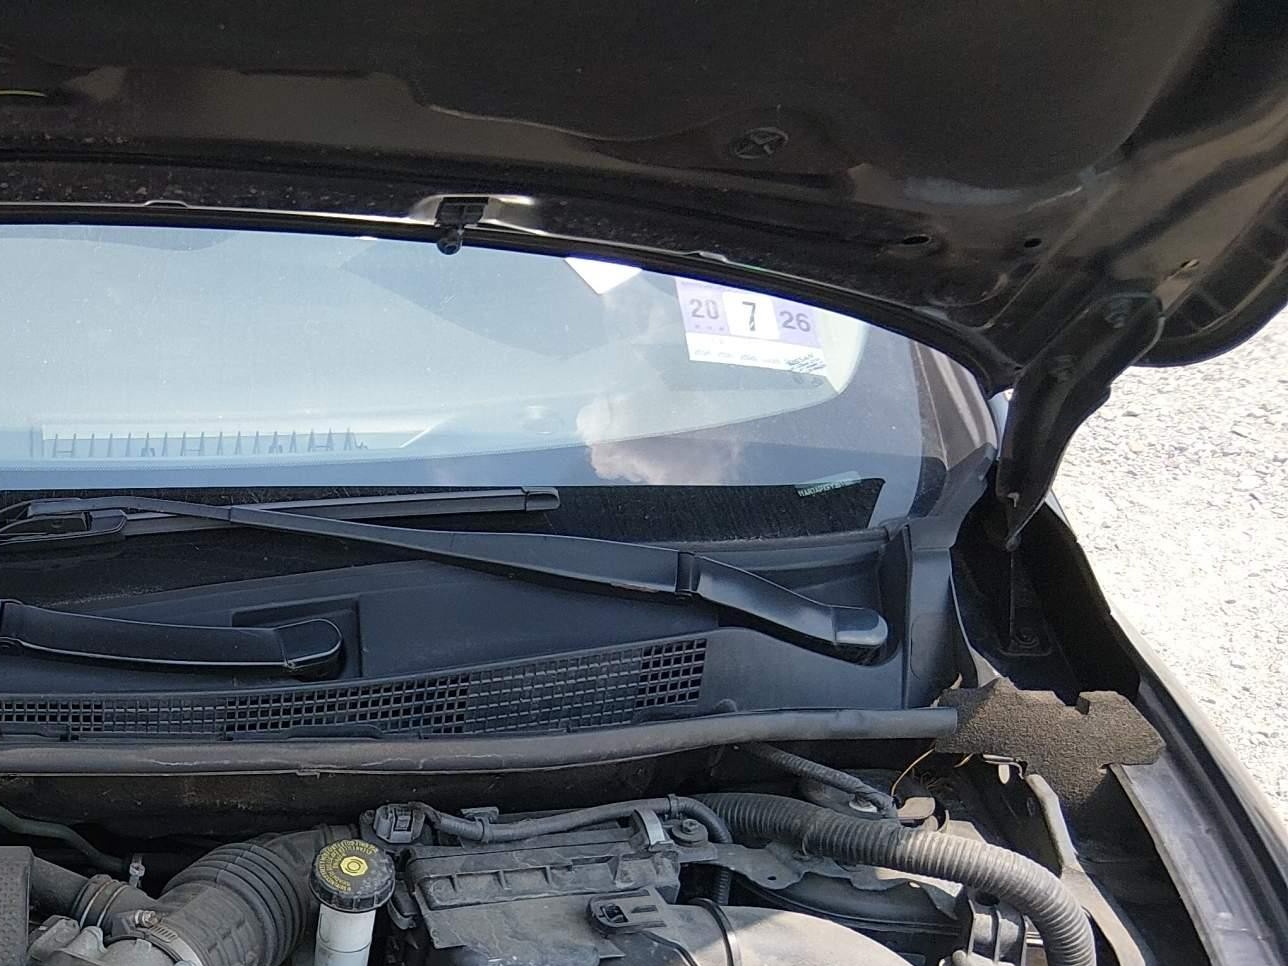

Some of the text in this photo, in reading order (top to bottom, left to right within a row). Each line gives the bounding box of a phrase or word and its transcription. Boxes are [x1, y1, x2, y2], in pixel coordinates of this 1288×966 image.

[689, 298, 811, 333] 20 7 26
